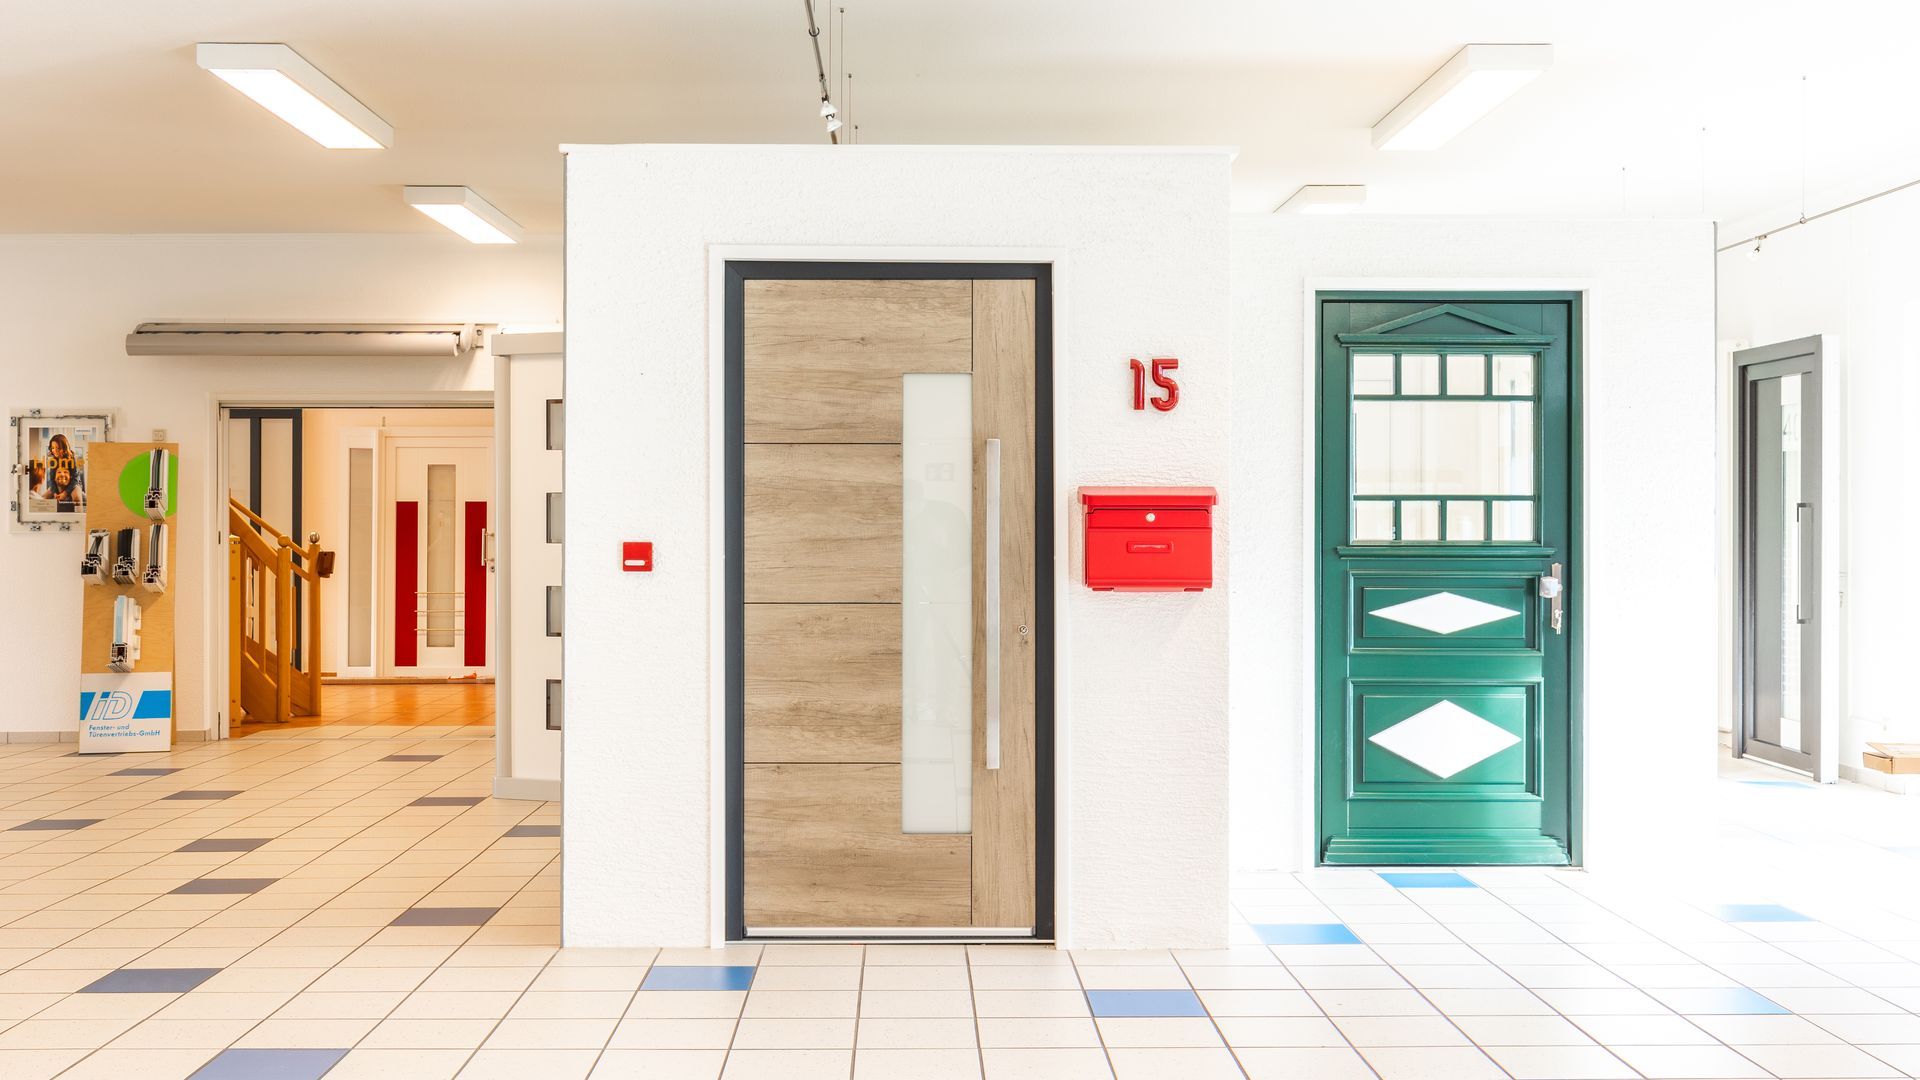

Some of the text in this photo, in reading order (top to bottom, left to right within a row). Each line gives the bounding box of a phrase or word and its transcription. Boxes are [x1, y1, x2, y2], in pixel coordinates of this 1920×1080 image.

[1129, 358, 1179, 412] 15
[88, 723, 130, 732] Fenster- und
